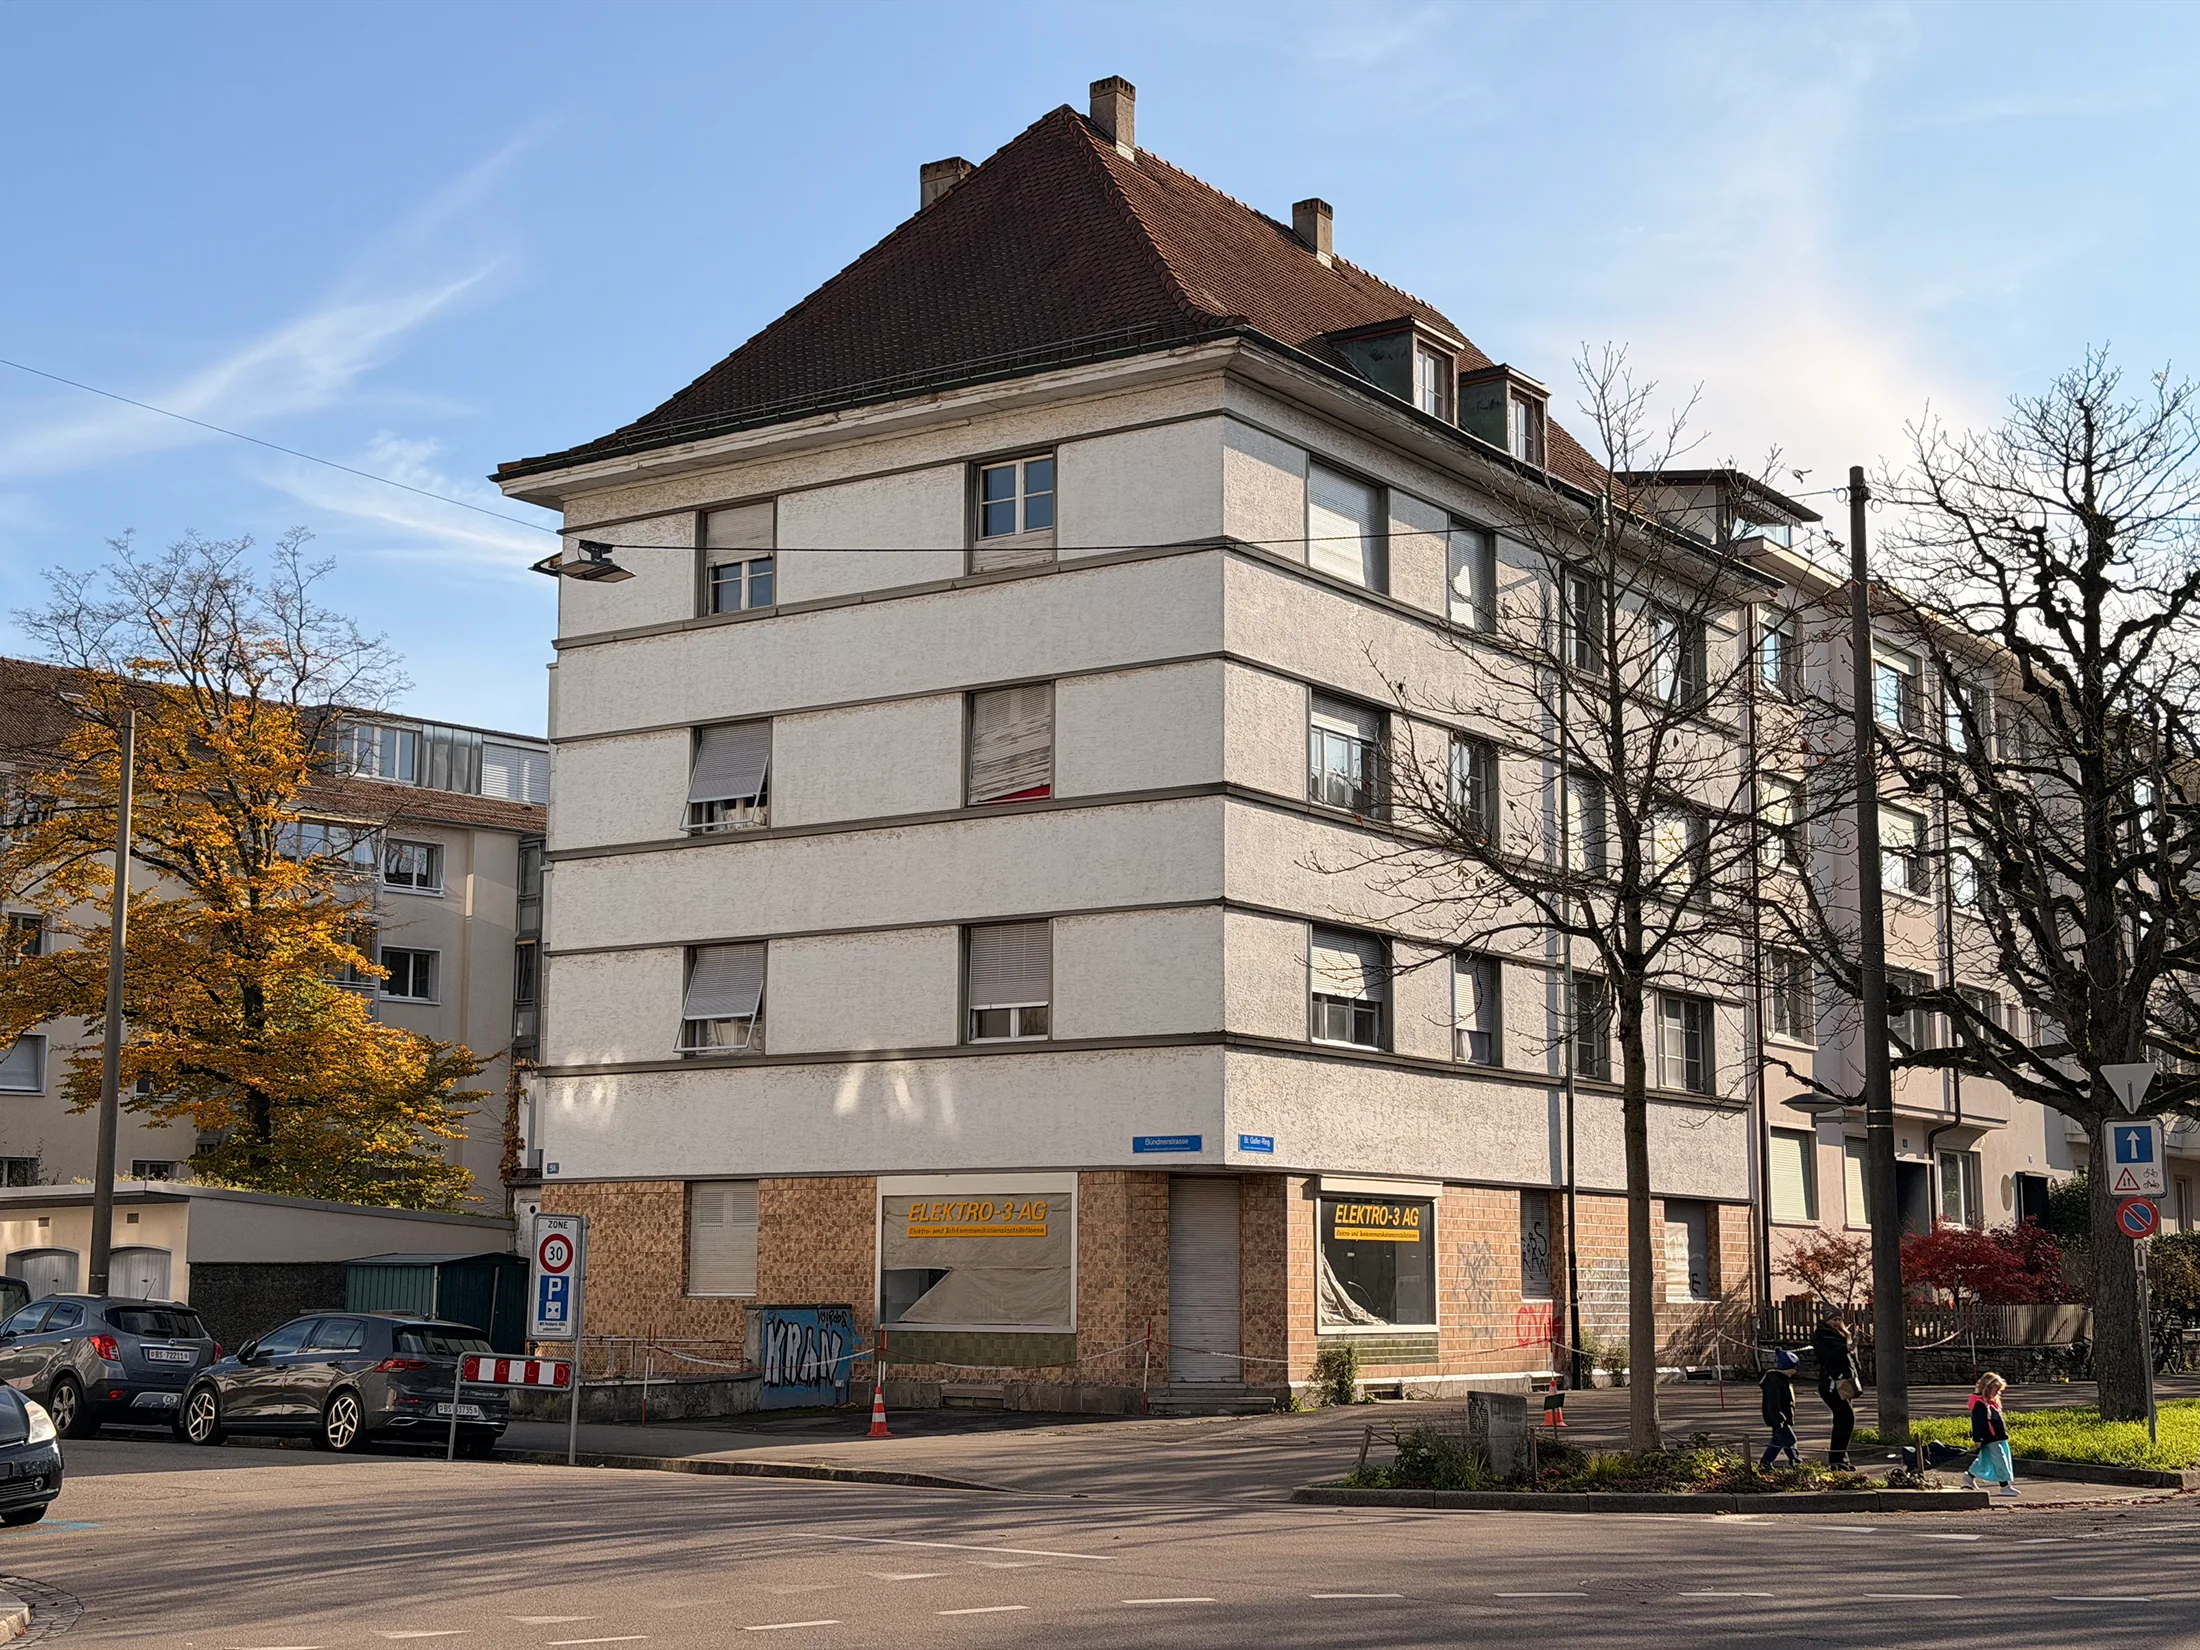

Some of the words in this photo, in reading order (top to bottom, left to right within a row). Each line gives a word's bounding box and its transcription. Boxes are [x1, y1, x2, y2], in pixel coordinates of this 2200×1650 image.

[1144, 1137, 1189, 1146] Bündnerstrasse
[908, 1201, 1015, 1222] ELEKTRO-3
[1017, 1200, 1047, 1221] AG
[1334, 1204, 1400, 1226] ELEKTRO-3
[1401, 1207, 1419, 1226] AG
[547, 1220, 569, 1229] ZONE
[909, 1227, 932, 1235] Elektro-
[932, 1227, 944, 1235] und
[548, 1246, 563, 1261] 30
[547, 1277, 562, 1300] P
[155, 1350, 163, 1359] BS
[165, 1351, 184, 1360] 72211
